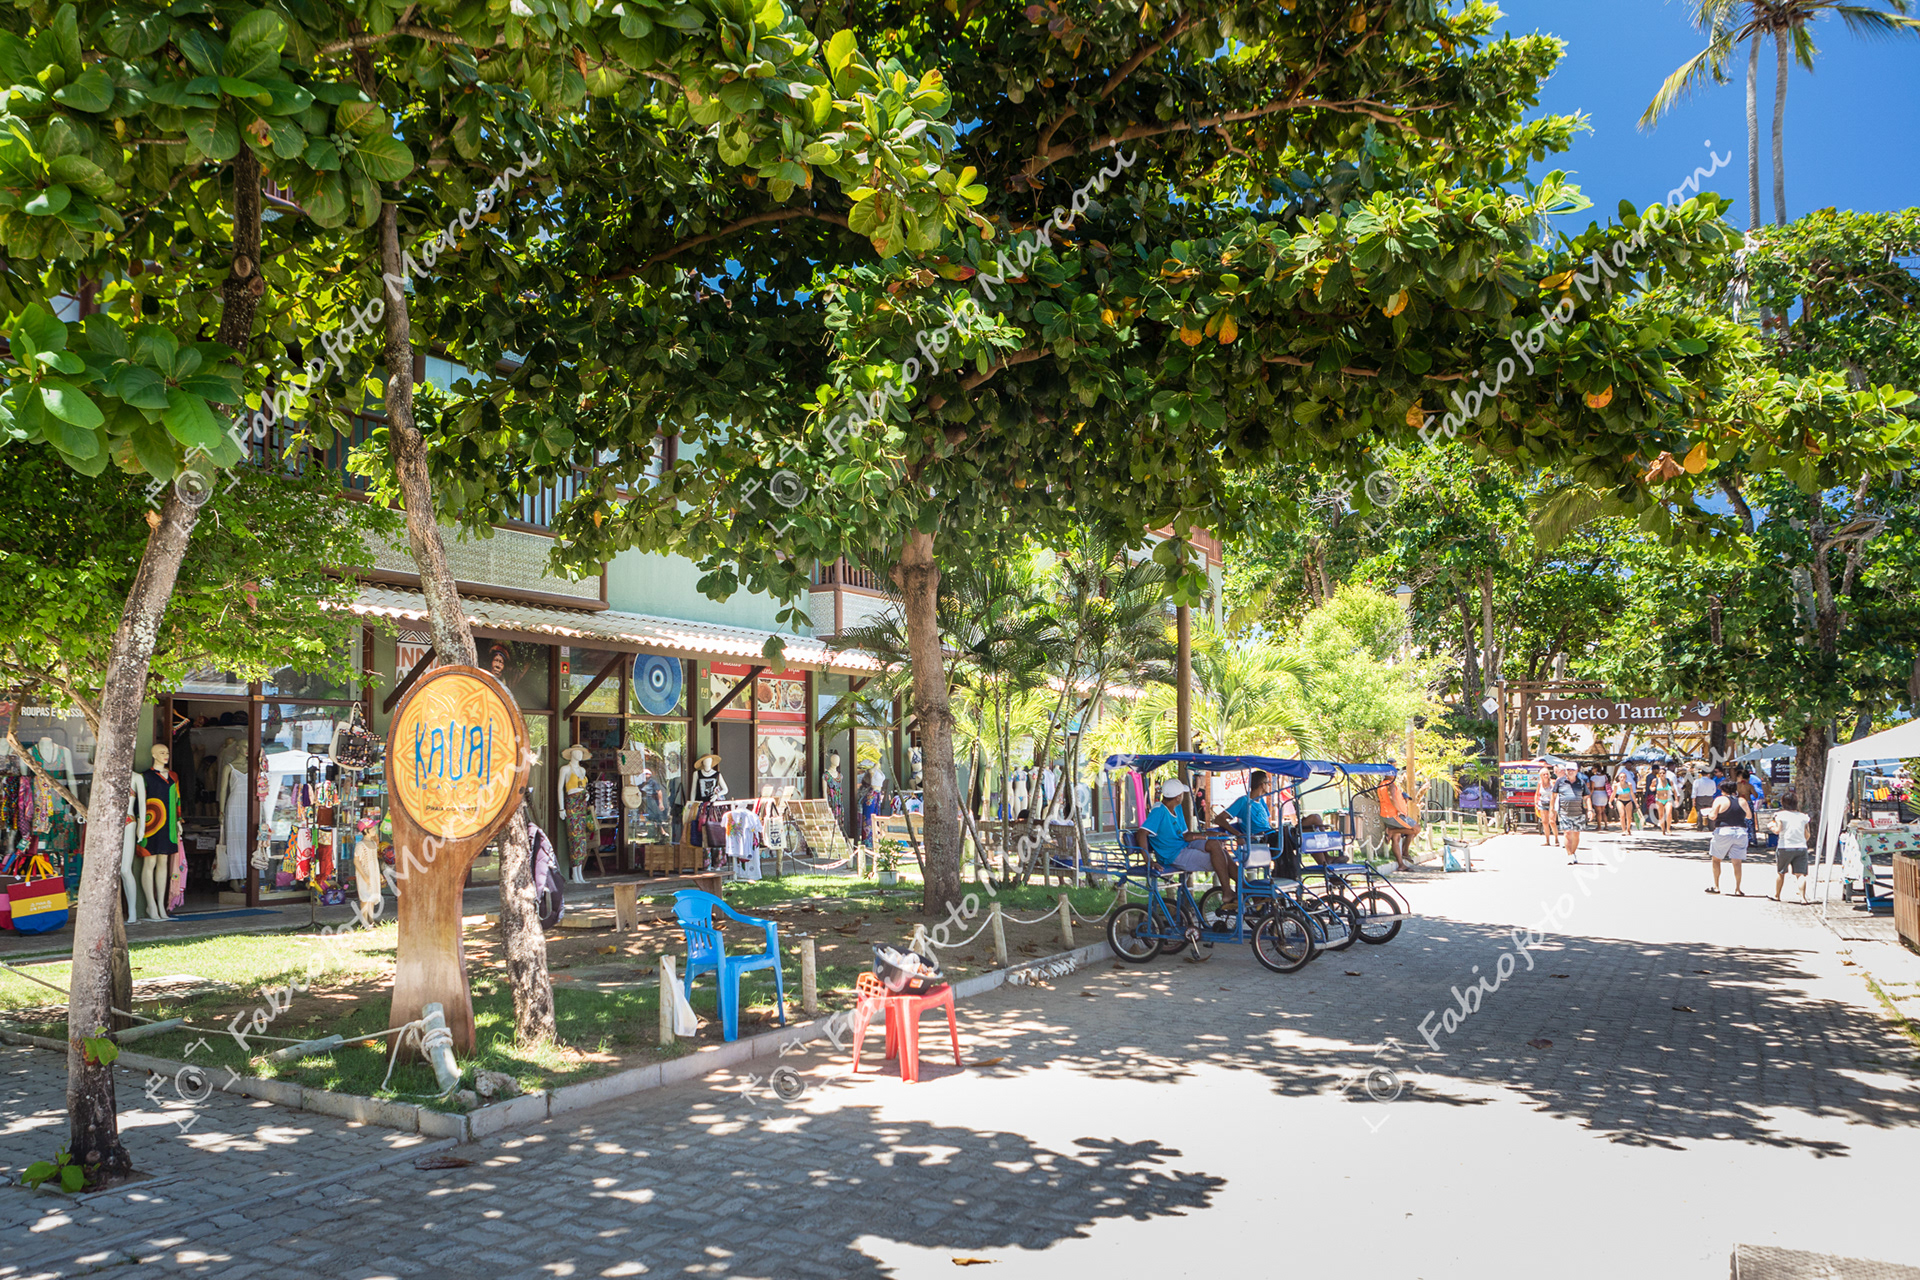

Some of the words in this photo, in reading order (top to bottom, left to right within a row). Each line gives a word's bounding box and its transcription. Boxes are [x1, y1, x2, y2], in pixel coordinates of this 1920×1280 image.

[21, 706, 50, 717] ROUPAS
[51, 708, 56, 717] E
[1535, 704, 1609, 723] Projeto
[1615, 704, 1687, 720] Tamr
